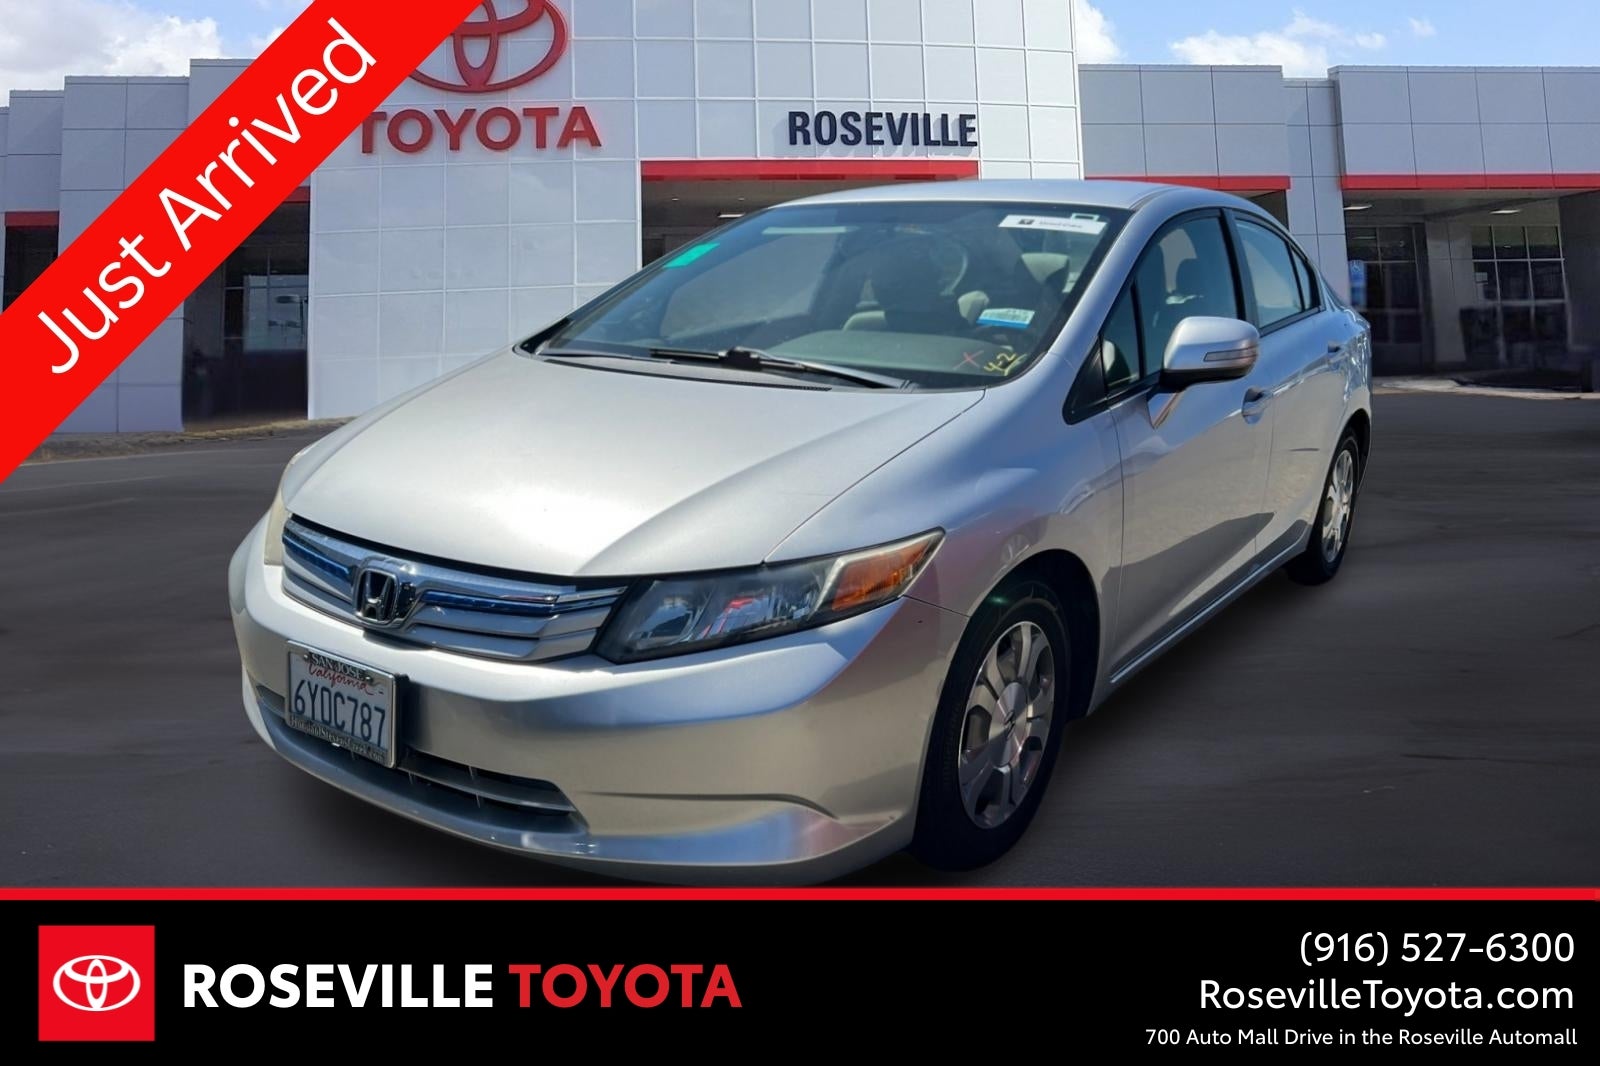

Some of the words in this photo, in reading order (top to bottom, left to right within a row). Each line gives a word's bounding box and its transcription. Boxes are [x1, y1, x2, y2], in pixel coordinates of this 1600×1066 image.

[361, 106, 602, 154] TOYOTA
[788, 110, 978, 147] ROSEVILLE
[308, 663, 374, 695] California
[311, 653, 333, 671] SAN
[334, 661, 365, 679] JOSE
